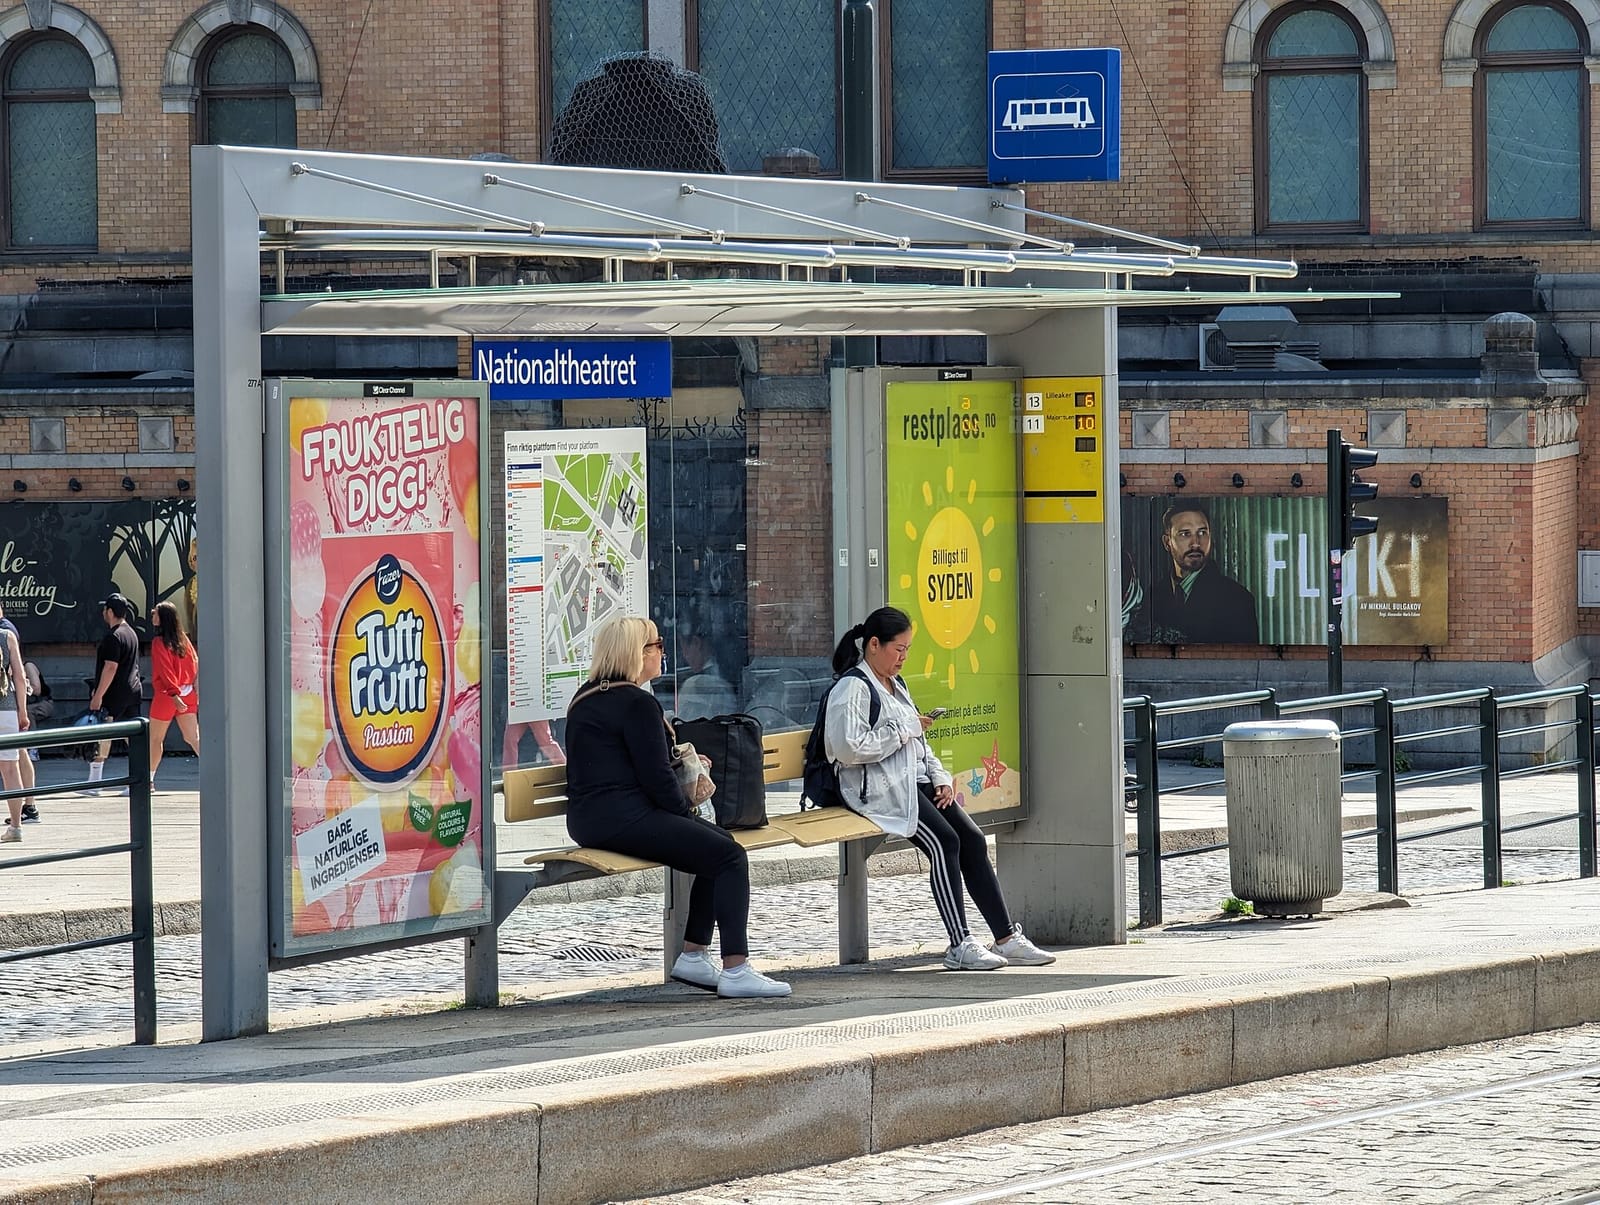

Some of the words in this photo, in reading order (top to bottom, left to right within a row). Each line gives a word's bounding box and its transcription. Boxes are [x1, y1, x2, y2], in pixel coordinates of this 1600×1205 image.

[478, 347, 637, 385] Nationaltheatret
[1029, 396, 1040, 408] 13
[1085, 394, 1094, 408] 6
[1026, 418, 1040, 430] 11
[1078, 417, 1095, 430] 10
[302, 399, 465, 480] FRUKTELIG
[507, 443, 518, 452] Finn
[518, 442, 532, 454] riktig
[533, 442, 556, 453] plattform
[557, 442, 567, 451] Find
[567, 443, 578, 452] your
[347, 461, 426, 525] DIGG!
[932, 548, 959, 568] Billigst
[960, 547, 968, 563] til
[376, 562, 401, 593] Fazer
[928, 571, 973, 603] SYDEN
[5, 600, 29, 608] DICKENS
[355, 609, 425, 671] Tutti
[350, 654, 428, 716] Frutti
[963, 704, 971, 719] på
[972, 703, 982, 716] ett
[364, 723, 414, 749] Passion
[413, 811, 426, 826] FREE
[437, 817, 460, 830] COLOURS
[440, 808, 462, 820] NATURAL
[327, 818, 353, 844] BARE
[439, 824, 465, 839] FLAVOURS
[314, 828, 369, 870] NATURLIGE
[310, 841, 380, 891] INGREDIENSER
